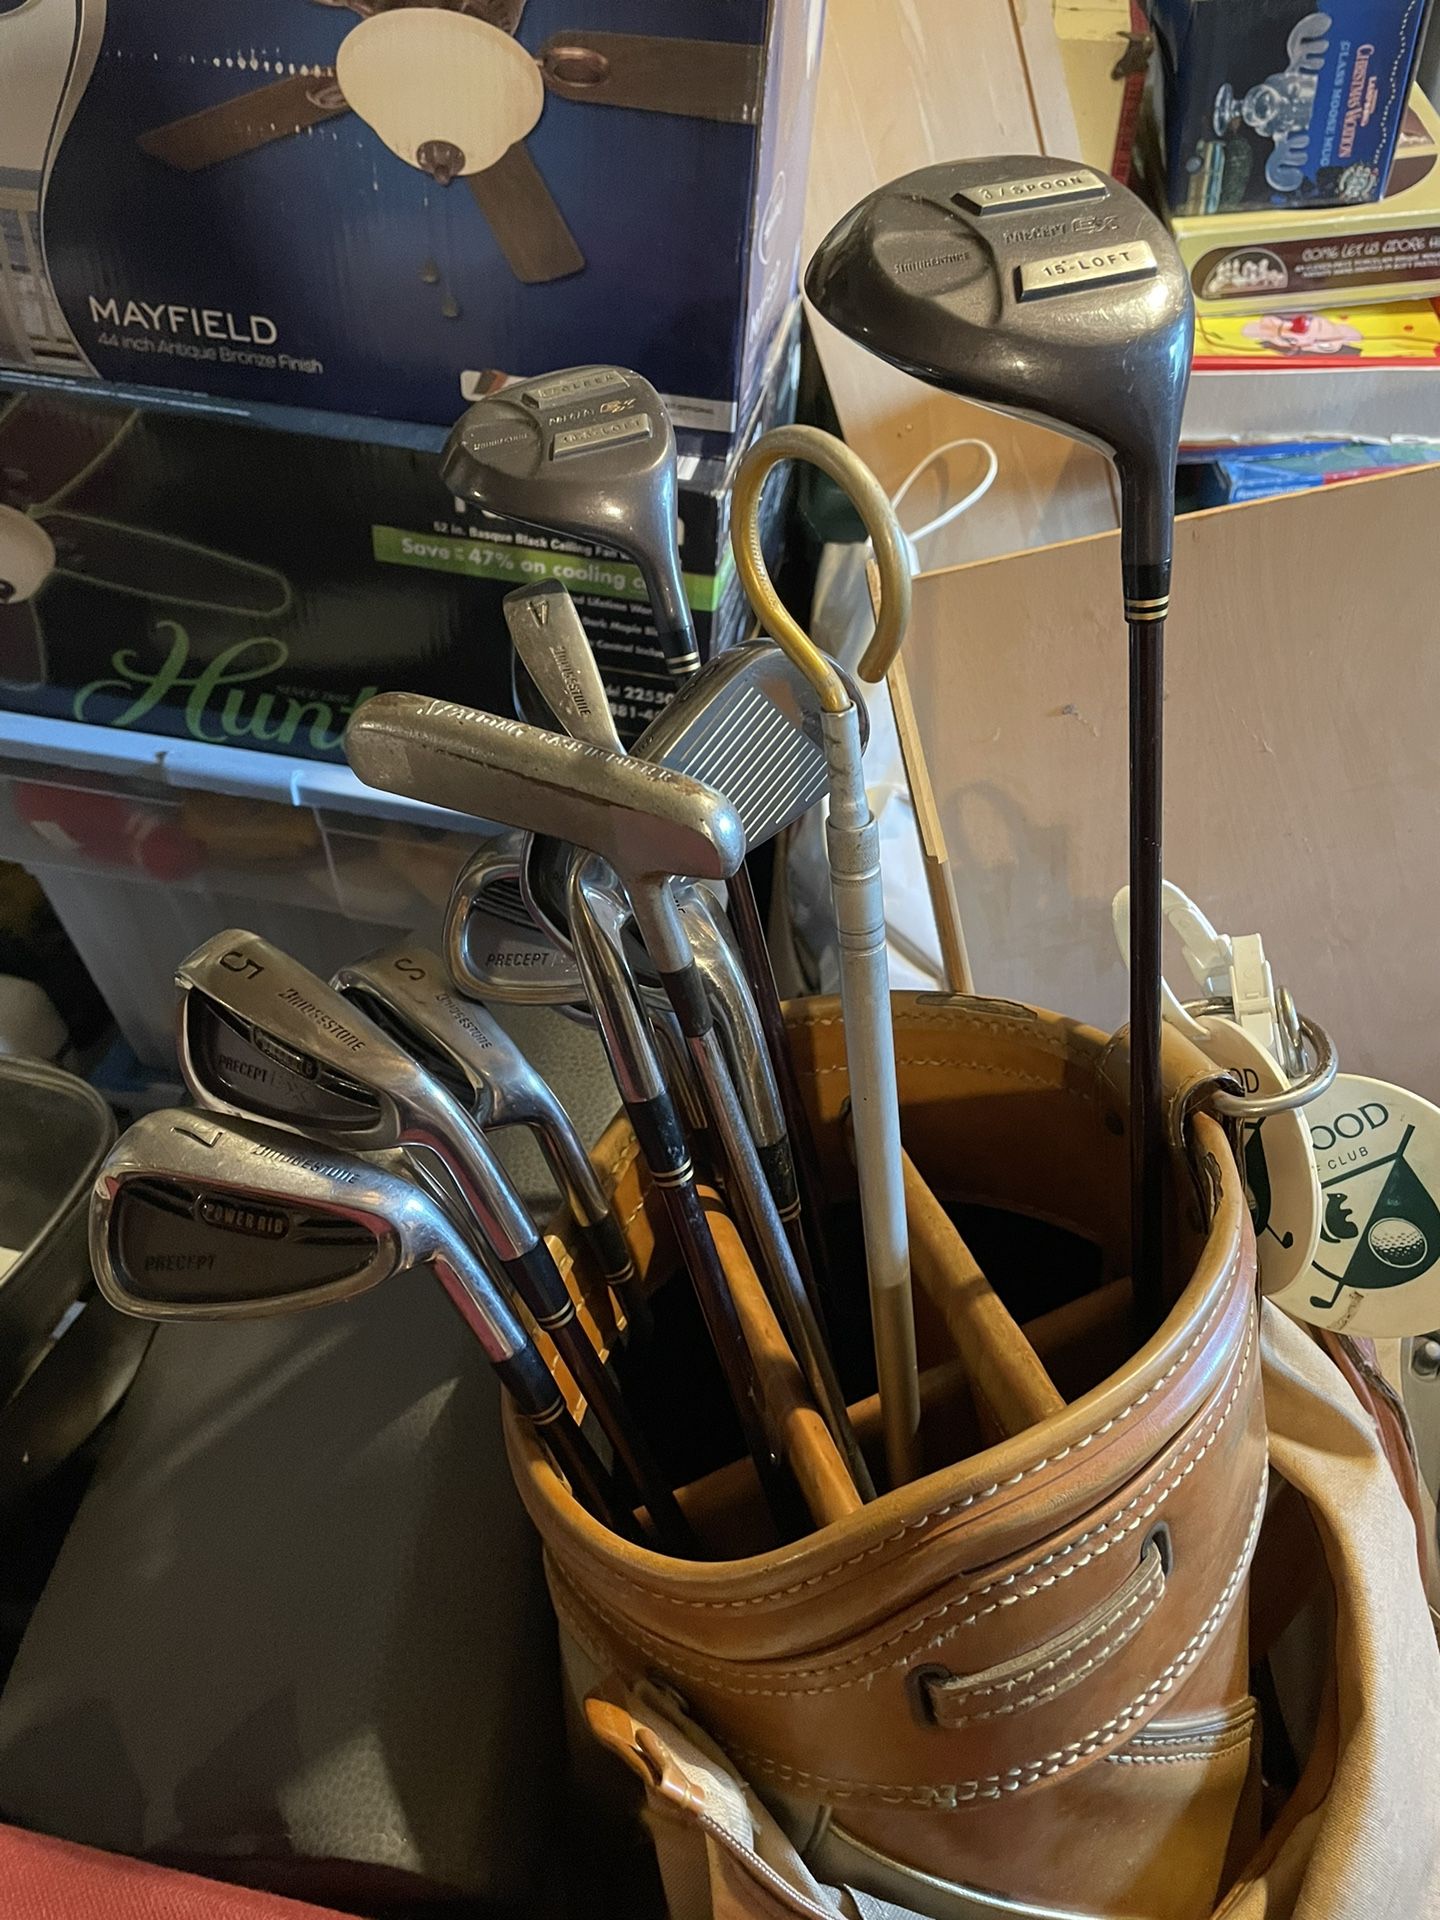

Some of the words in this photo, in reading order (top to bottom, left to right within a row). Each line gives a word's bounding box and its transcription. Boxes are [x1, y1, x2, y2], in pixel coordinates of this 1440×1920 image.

[88, 295, 278, 345] MAYFIELD
[515, 532, 548, 549] Black
[402, 537, 449, 561] Save
[467, 547, 514, 571] 47%
[520, 559, 547, 576] on
[552, 562, 626, 591] cooling
[219, 951, 265, 980] 5
[394, 958, 426, 981] S
[485, 951, 550, 968] PRECEPT
[218, 1055, 267, 1083] PRECEPT
[170, 1127, 224, 1149] 7
[1327, 1146, 1369, 1171] CLUB
[145, 1253, 215, 1272] PRECEPT
